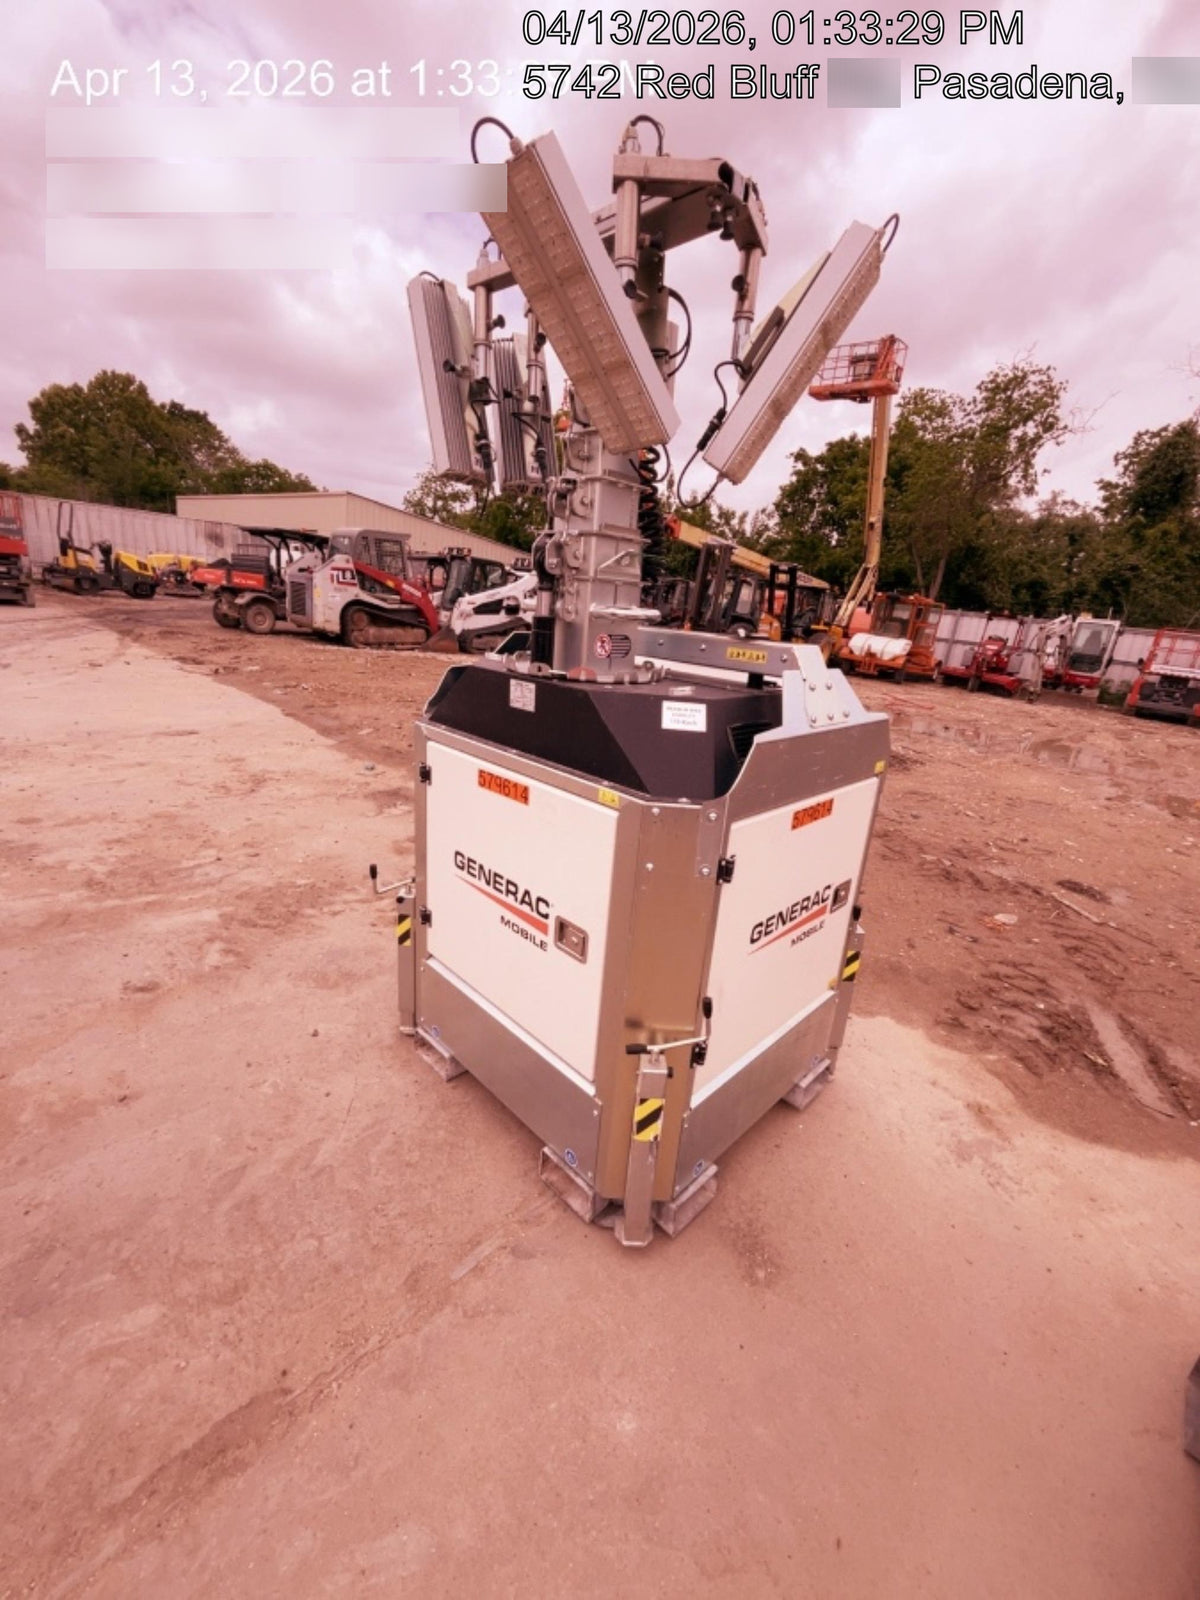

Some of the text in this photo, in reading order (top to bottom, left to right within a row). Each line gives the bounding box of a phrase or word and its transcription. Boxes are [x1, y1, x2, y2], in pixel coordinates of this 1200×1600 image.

[478, 768, 530, 805] 579614
[792, 798, 835, 830] 579614
[454, 850, 550, 920] GENERAC
[750, 884, 832, 944] GENERAC
[500, 915, 548, 952] MOBILE
[790, 920, 825, 947] MOBILE
